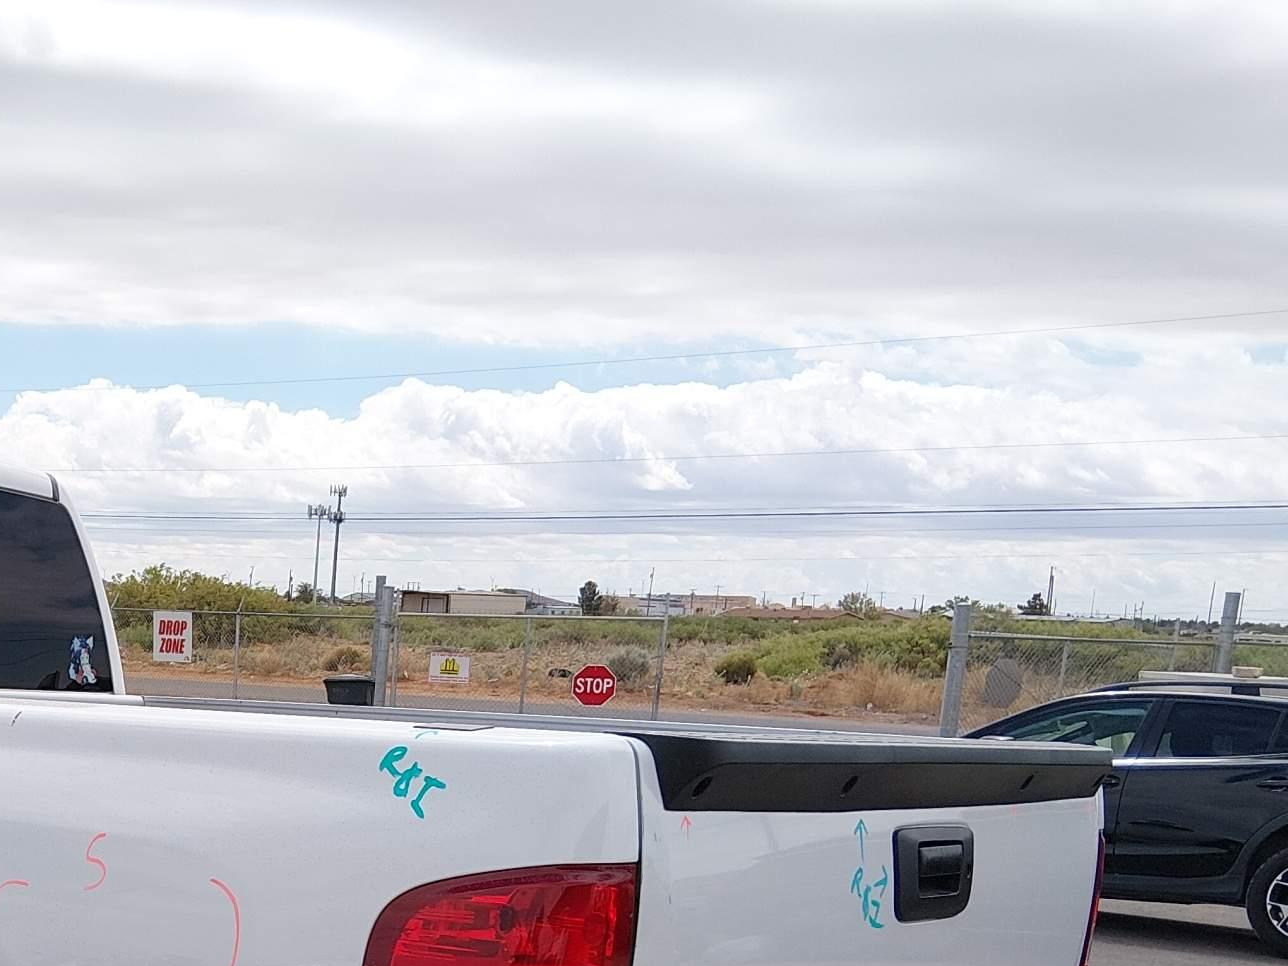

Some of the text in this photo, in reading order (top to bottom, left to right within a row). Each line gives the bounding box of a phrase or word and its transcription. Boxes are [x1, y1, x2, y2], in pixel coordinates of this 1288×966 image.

[158, 619, 188, 637] DROP
[159, 637, 186, 655] ZONE
[574, 677, 614, 694] STOP
